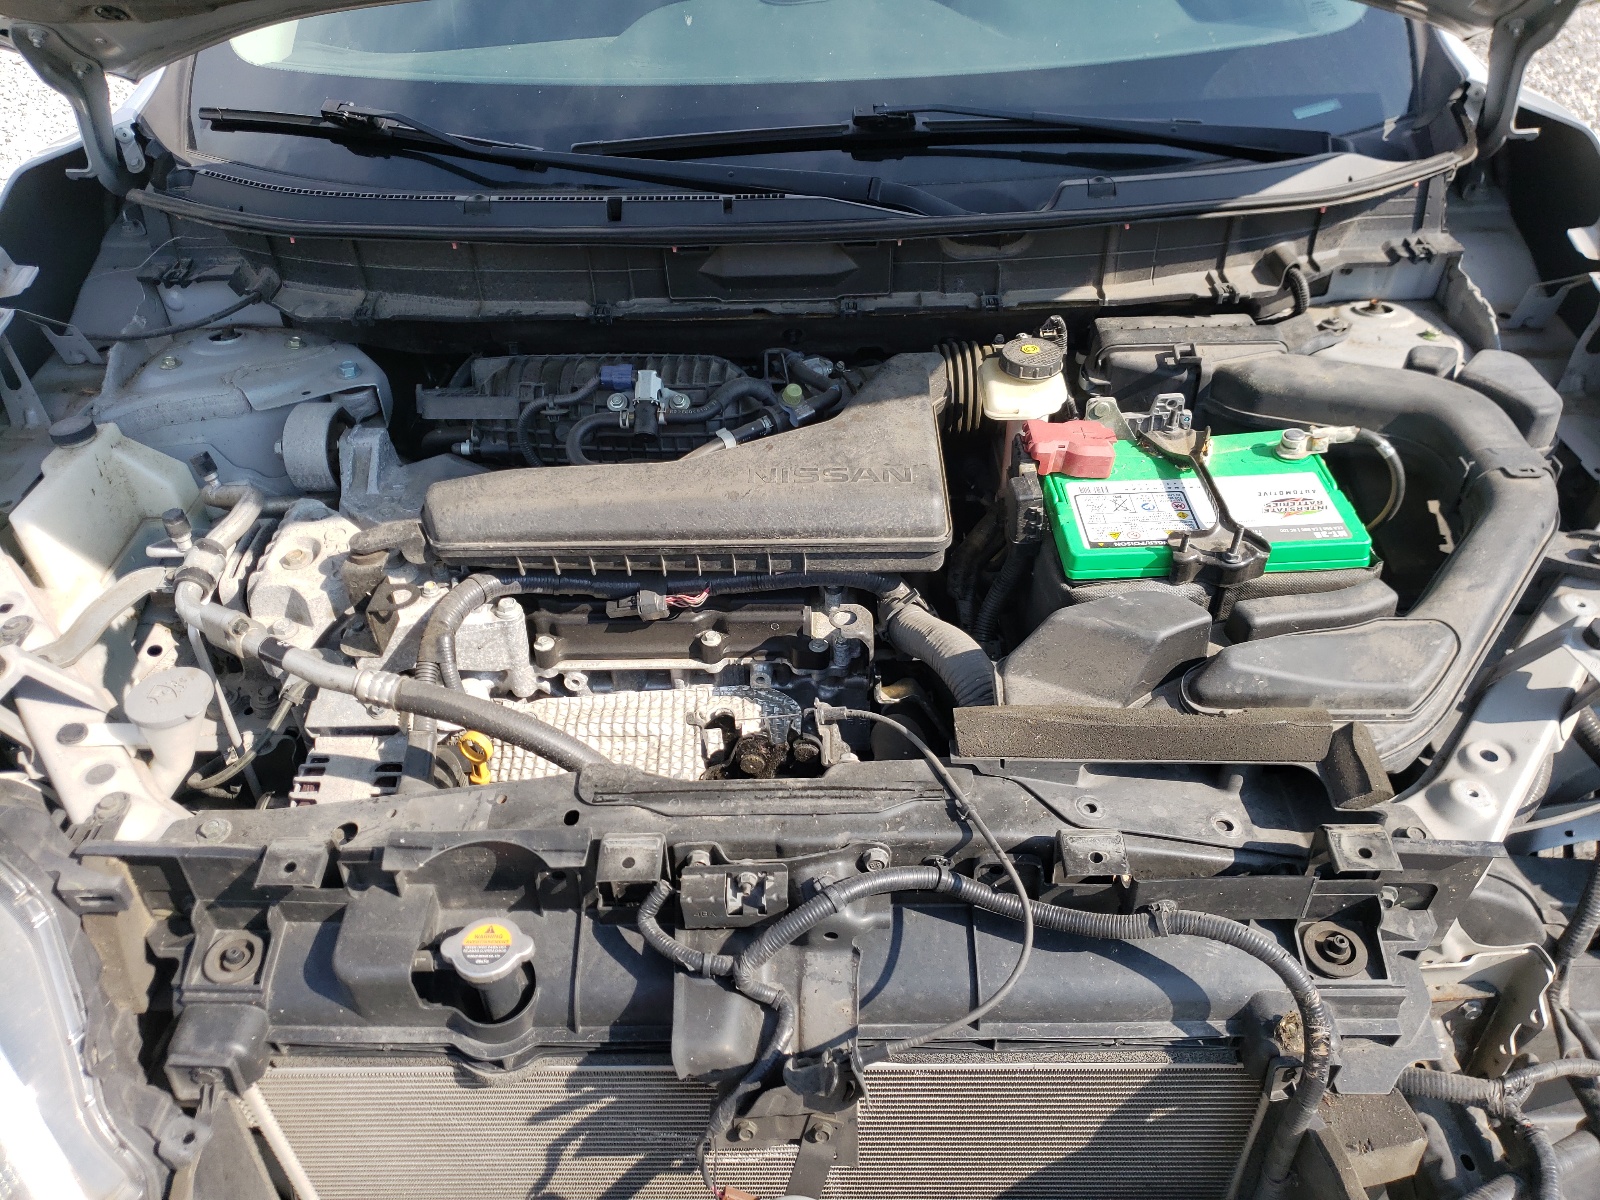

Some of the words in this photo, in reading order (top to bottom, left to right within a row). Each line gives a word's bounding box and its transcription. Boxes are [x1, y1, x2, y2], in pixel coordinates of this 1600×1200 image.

[748, 467, 912, 484] NISSAN
[1257, 489, 1316, 497] AUTOMOTIVE
[1263, 500, 1323, 508] BATTERIES
[1263, 505, 1328, 514] INTERSTATE
